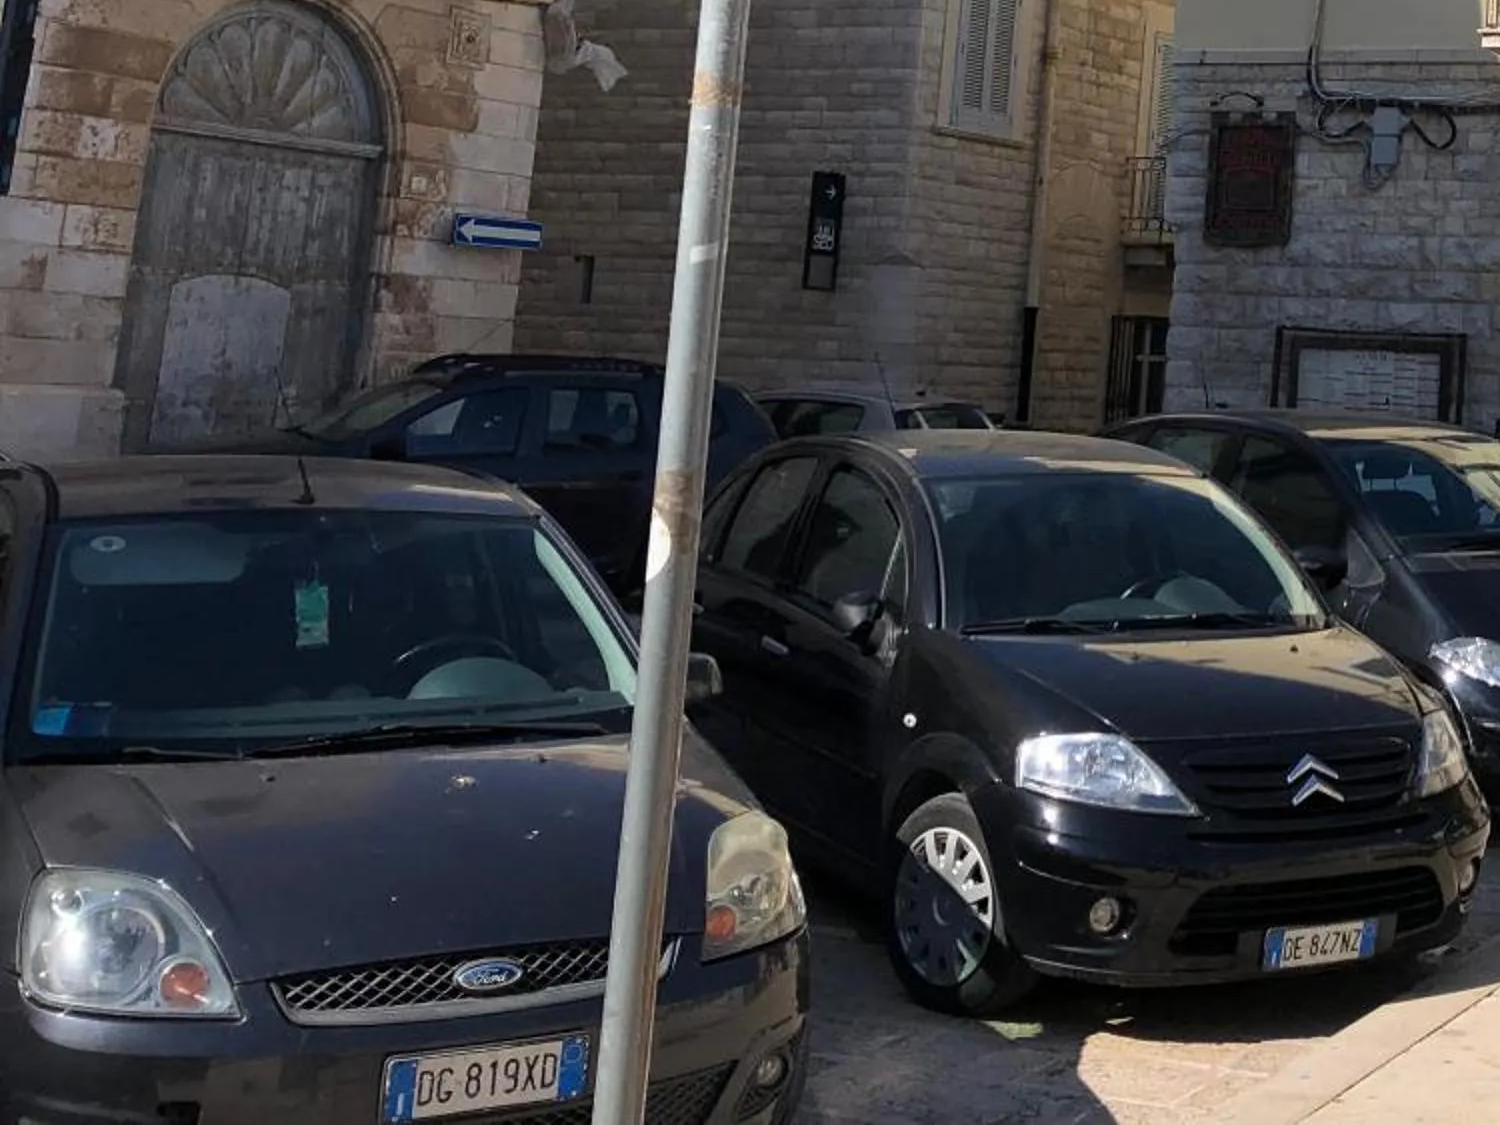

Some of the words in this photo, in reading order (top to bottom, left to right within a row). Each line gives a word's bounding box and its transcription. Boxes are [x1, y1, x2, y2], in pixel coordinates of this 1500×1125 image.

[1283, 936, 1303, 962] DE
[1309, 928, 1362, 957] 847NZ
[416, 1068, 453, 1107] DG
[465, 1053, 558, 1099] 819XD
